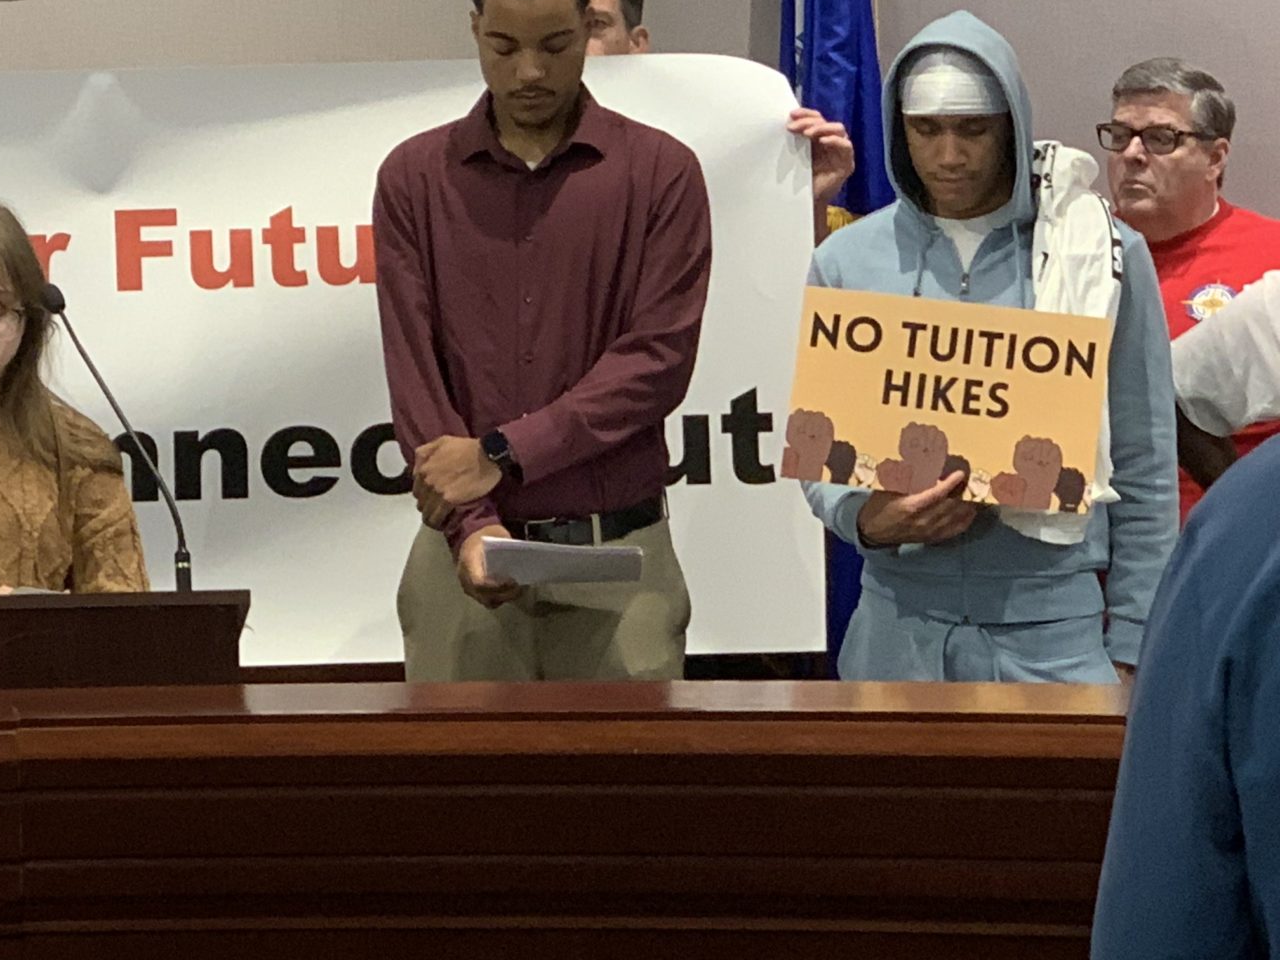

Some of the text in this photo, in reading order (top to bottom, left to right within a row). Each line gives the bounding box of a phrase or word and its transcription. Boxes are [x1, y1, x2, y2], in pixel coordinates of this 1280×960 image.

[114, 206, 377, 292] Futu
[809, 311, 1097, 380] NO TUITION
[881, 368, 1010, 419] HIKES
